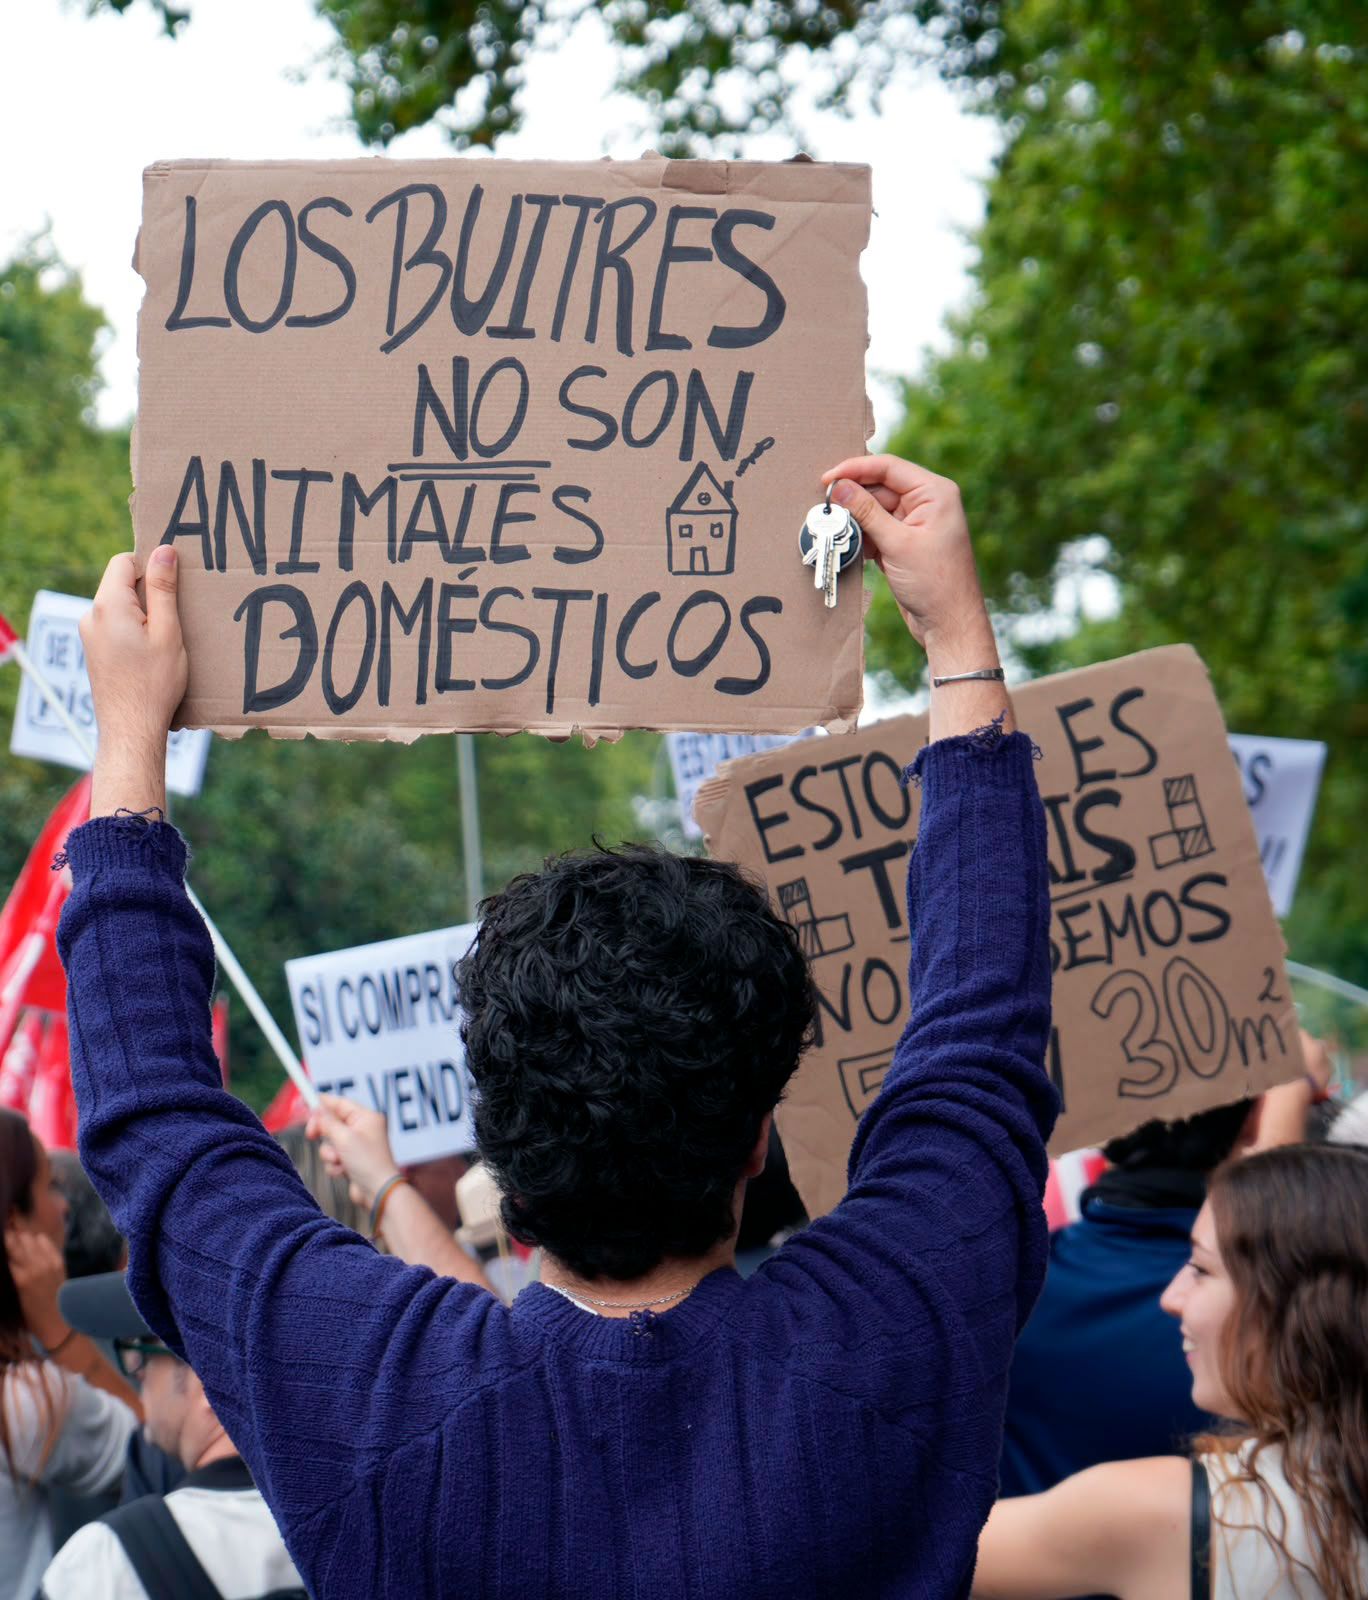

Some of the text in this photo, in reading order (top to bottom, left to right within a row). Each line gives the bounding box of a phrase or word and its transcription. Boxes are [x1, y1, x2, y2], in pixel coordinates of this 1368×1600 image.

[164, 183, 787, 358] LOS BUITRES
[412, 355, 755, 462] NO SON
[159, 455, 605, 577] ANIMALES
[233, 567, 783, 716] DOMÉSTICOS
[744, 751, 911, 863] ESTO
[1056, 687, 1158, 792] ES
[810, 958, 902, 1048] NO
